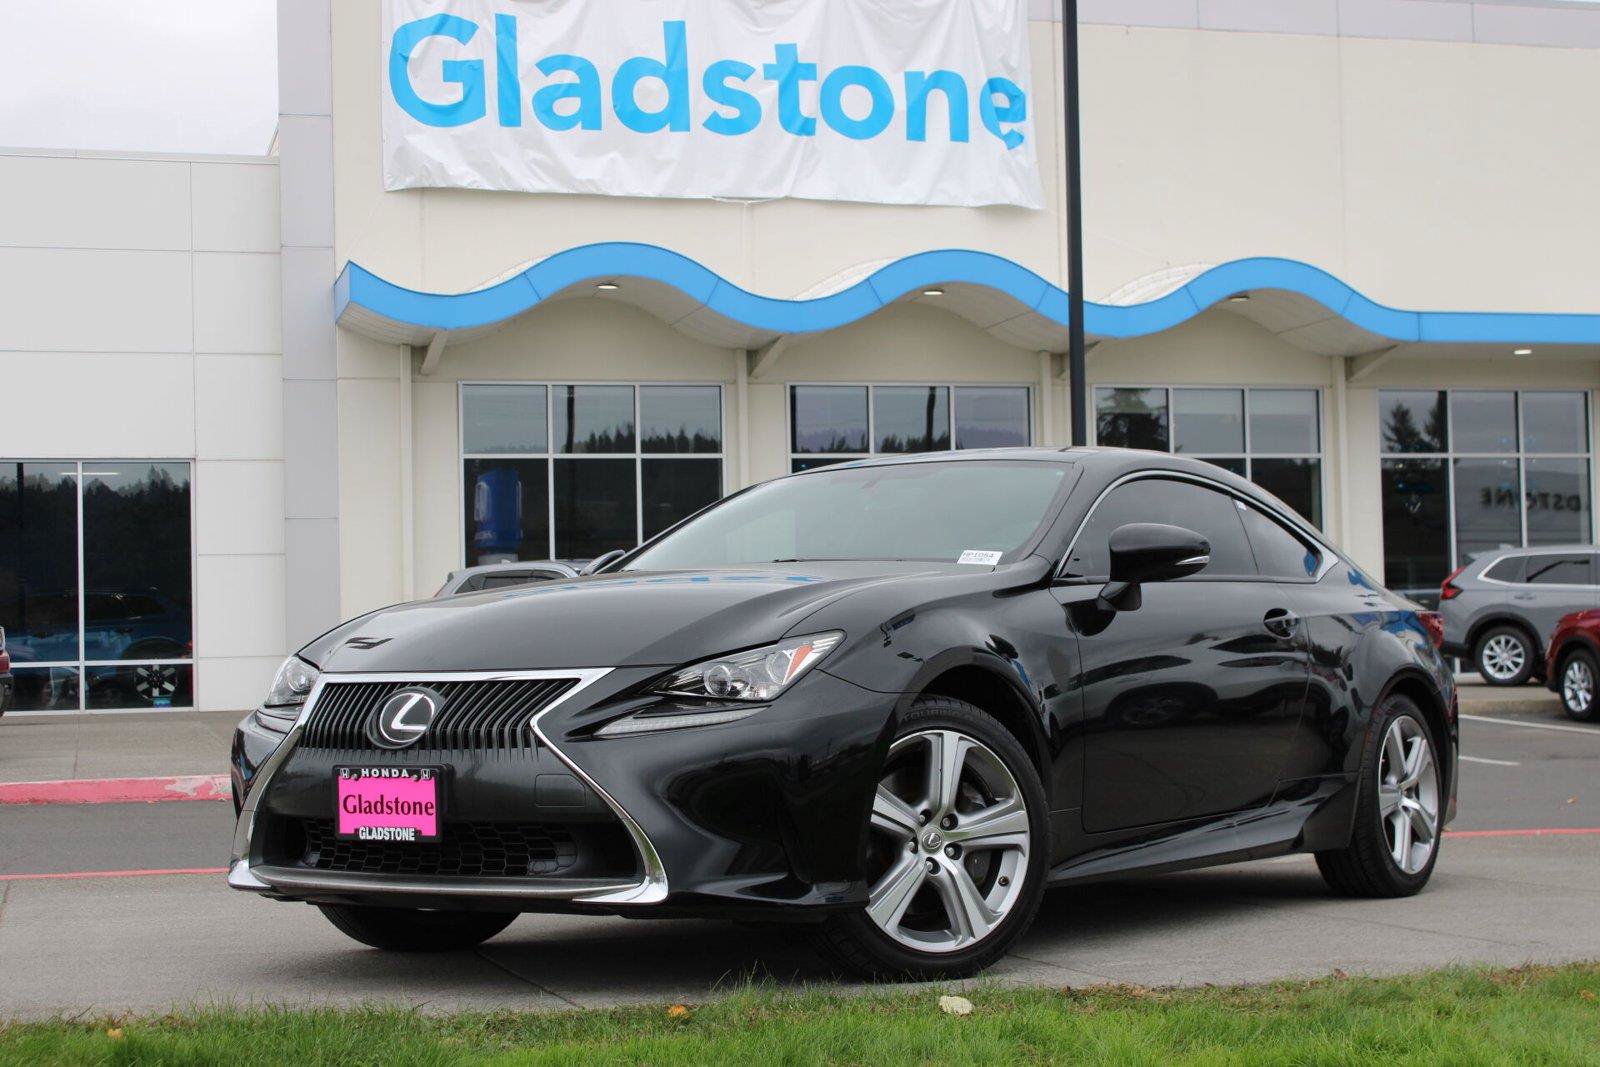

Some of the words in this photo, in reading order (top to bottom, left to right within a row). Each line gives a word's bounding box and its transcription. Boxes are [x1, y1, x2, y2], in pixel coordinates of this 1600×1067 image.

[388, 12, 1027, 151] Gladstone
[361, 768, 410, 778] HONDA
[342, 794, 435, 816] Gladstone
[358, 826, 416, 841] GLADSTONE
